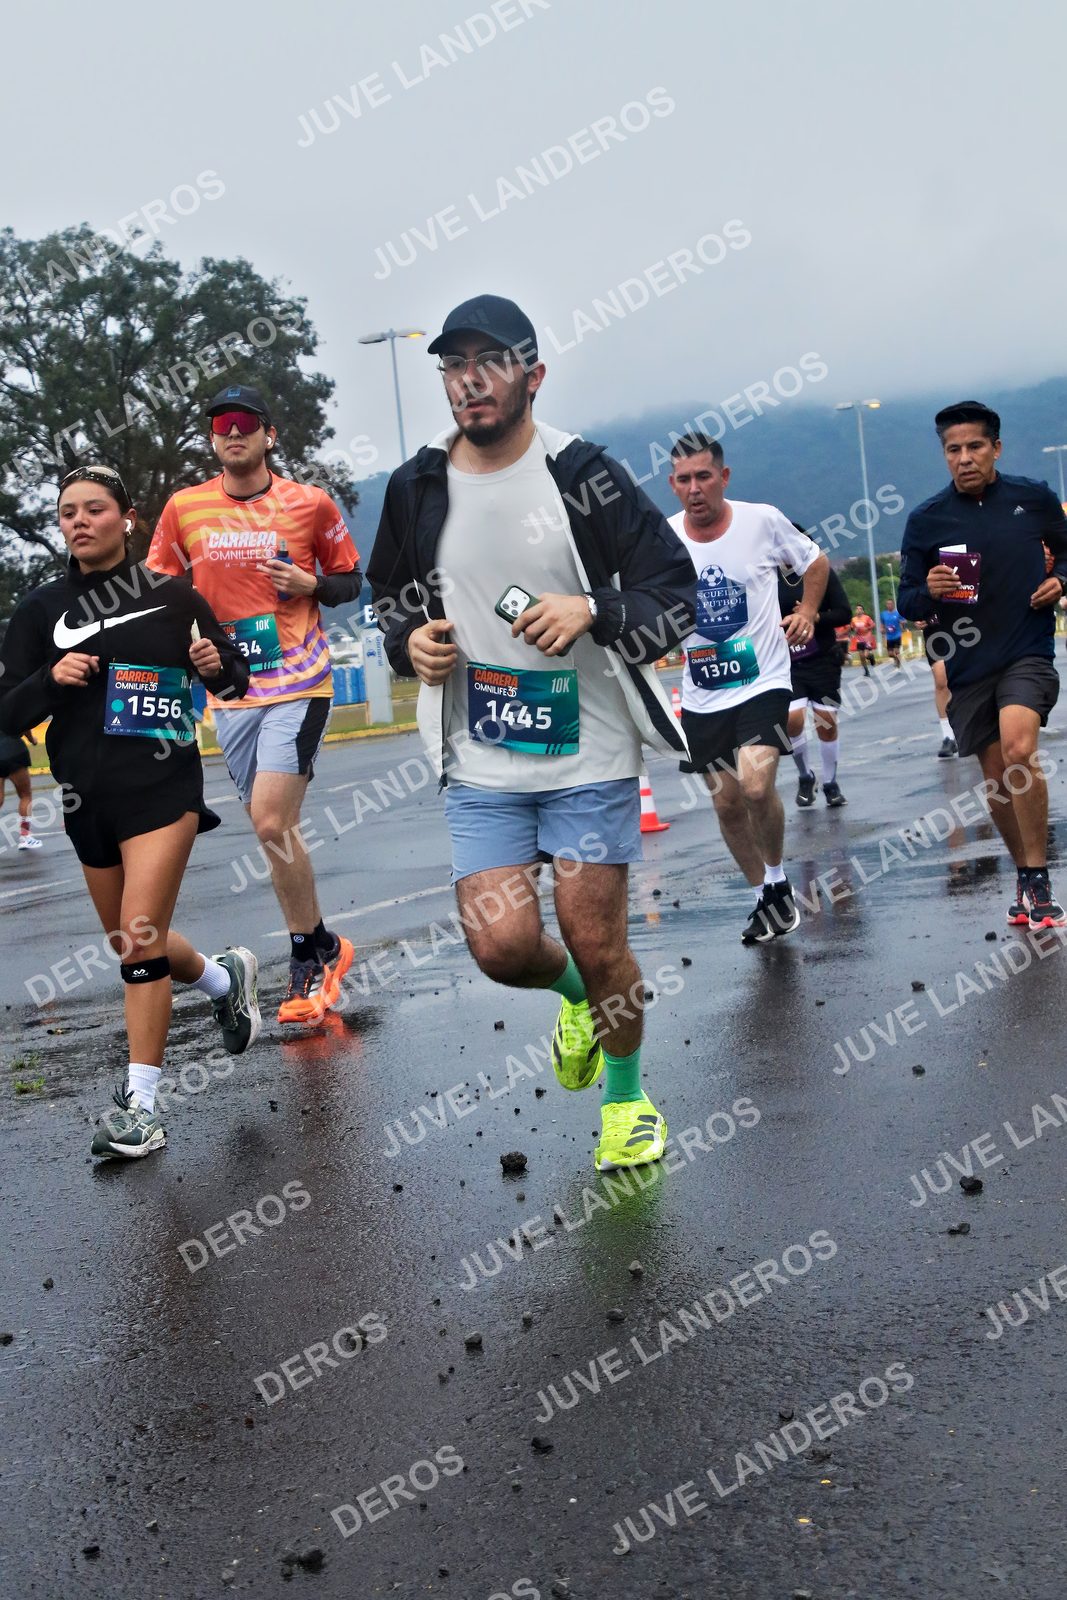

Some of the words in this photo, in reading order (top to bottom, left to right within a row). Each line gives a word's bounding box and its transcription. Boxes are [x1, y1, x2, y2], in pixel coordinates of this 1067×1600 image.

[209, 531, 277, 548] CARRERA
[697, 588, 738, 600] SCUELA
[255, 618, 270, 631] 10K
[733, 641, 747, 653] 10K
[115, 669, 159, 683] CARRERA
[474, 668, 519, 688] CARRERA
[700, 660, 741, 679] 1370
[551, 677, 571, 694] 10K
[127, 695, 182, 719] 1556
[486, 699, 553, 730] 1445
